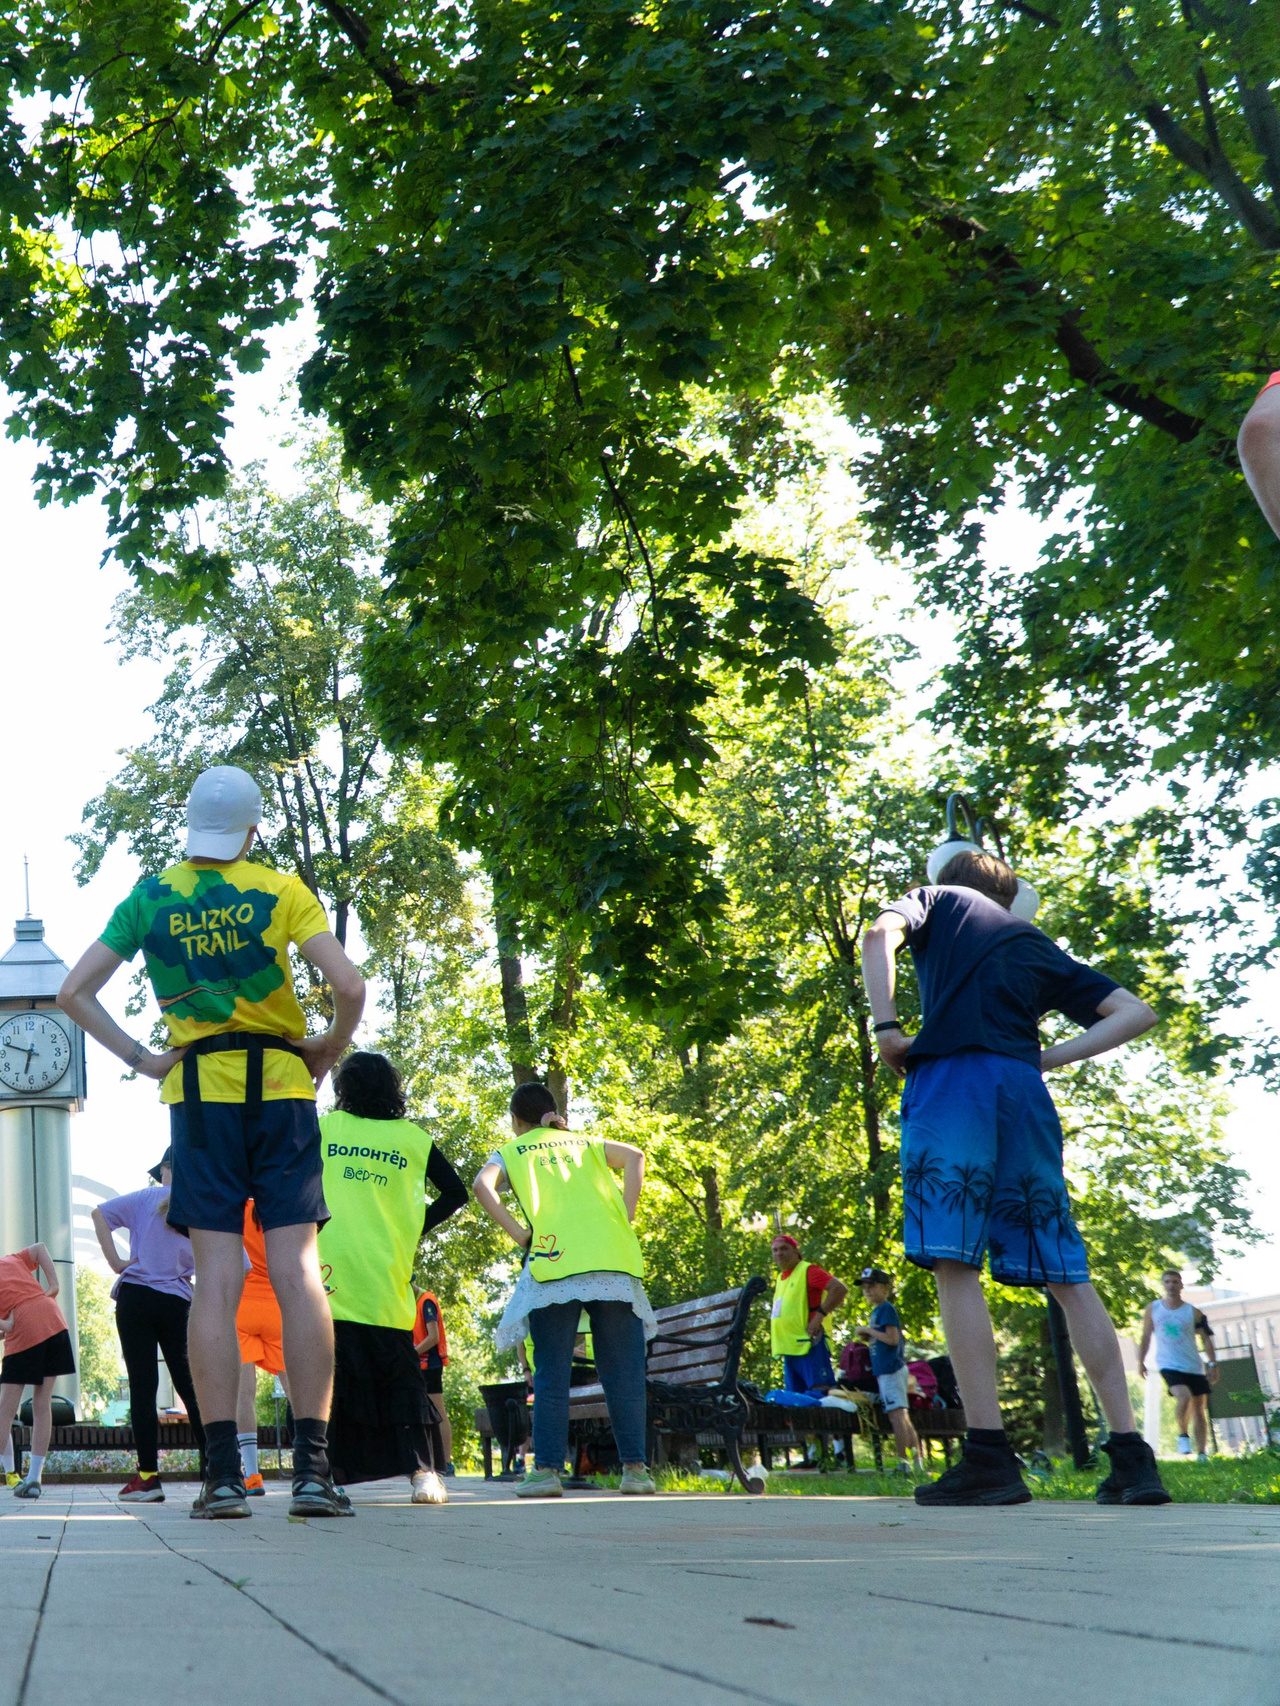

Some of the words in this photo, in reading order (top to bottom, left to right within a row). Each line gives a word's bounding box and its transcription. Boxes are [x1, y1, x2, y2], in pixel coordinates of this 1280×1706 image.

[169, 903, 254, 936] BLIZKO
[180, 929, 250, 960] TRAIL
[13, 1025, 20, 1035] 11
[25, 1020, 35, 1031] 12
[2, 1036, 12, 1046] 10
[50, 1033, 57, 1044] 2
[0, 1049, 7, 1059] 9
[54, 1047, 61, 1057] 3
[3, 1062, 11, 1072] 8
[51, 1060, 58, 1070] 4
[14, 1072, 20, 1082] 7
[28, 1075, 35, 1085] 6
[42, 1071, 48, 1081] 5
[327, 1143, 408, 1170] Волонтёр
